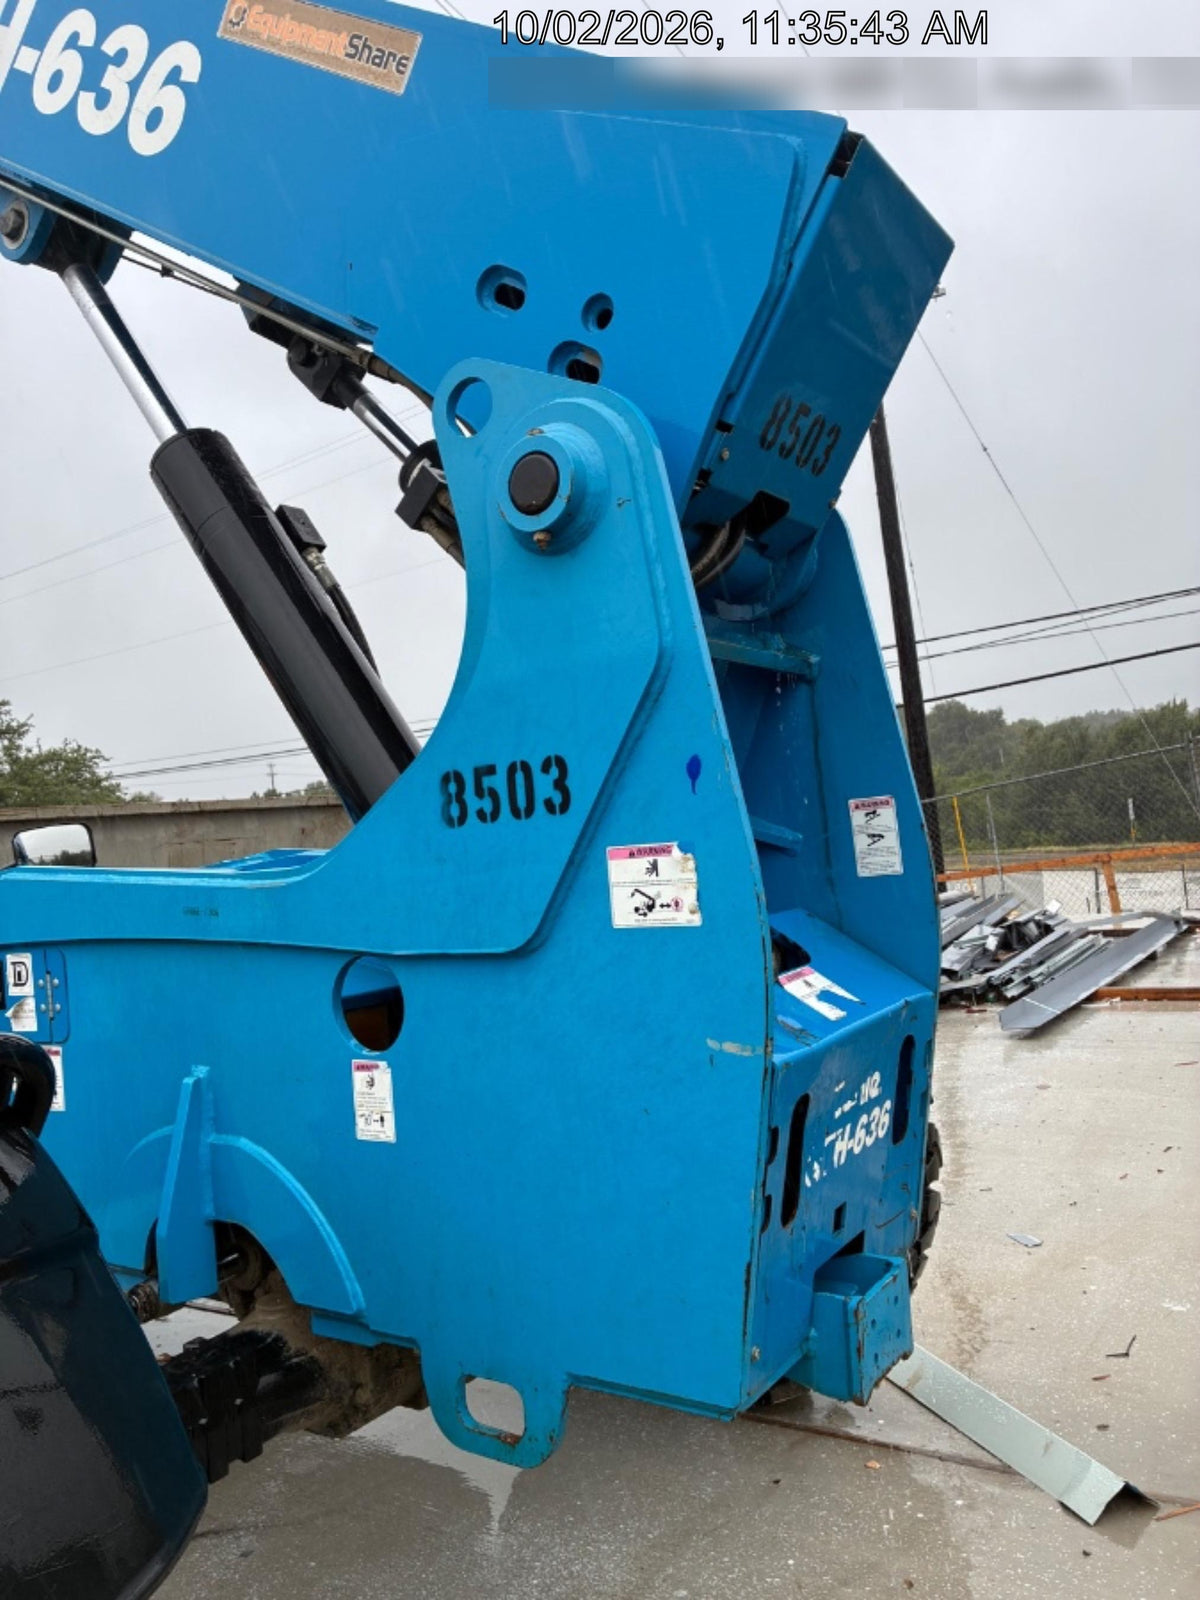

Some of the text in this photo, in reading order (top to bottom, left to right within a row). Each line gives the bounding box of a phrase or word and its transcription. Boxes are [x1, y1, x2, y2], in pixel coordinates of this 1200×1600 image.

[247, 4, 410, 75] EquipmentShare
[759, 391, 841, 477] 8503
[440, 754, 571, 828] 8503
